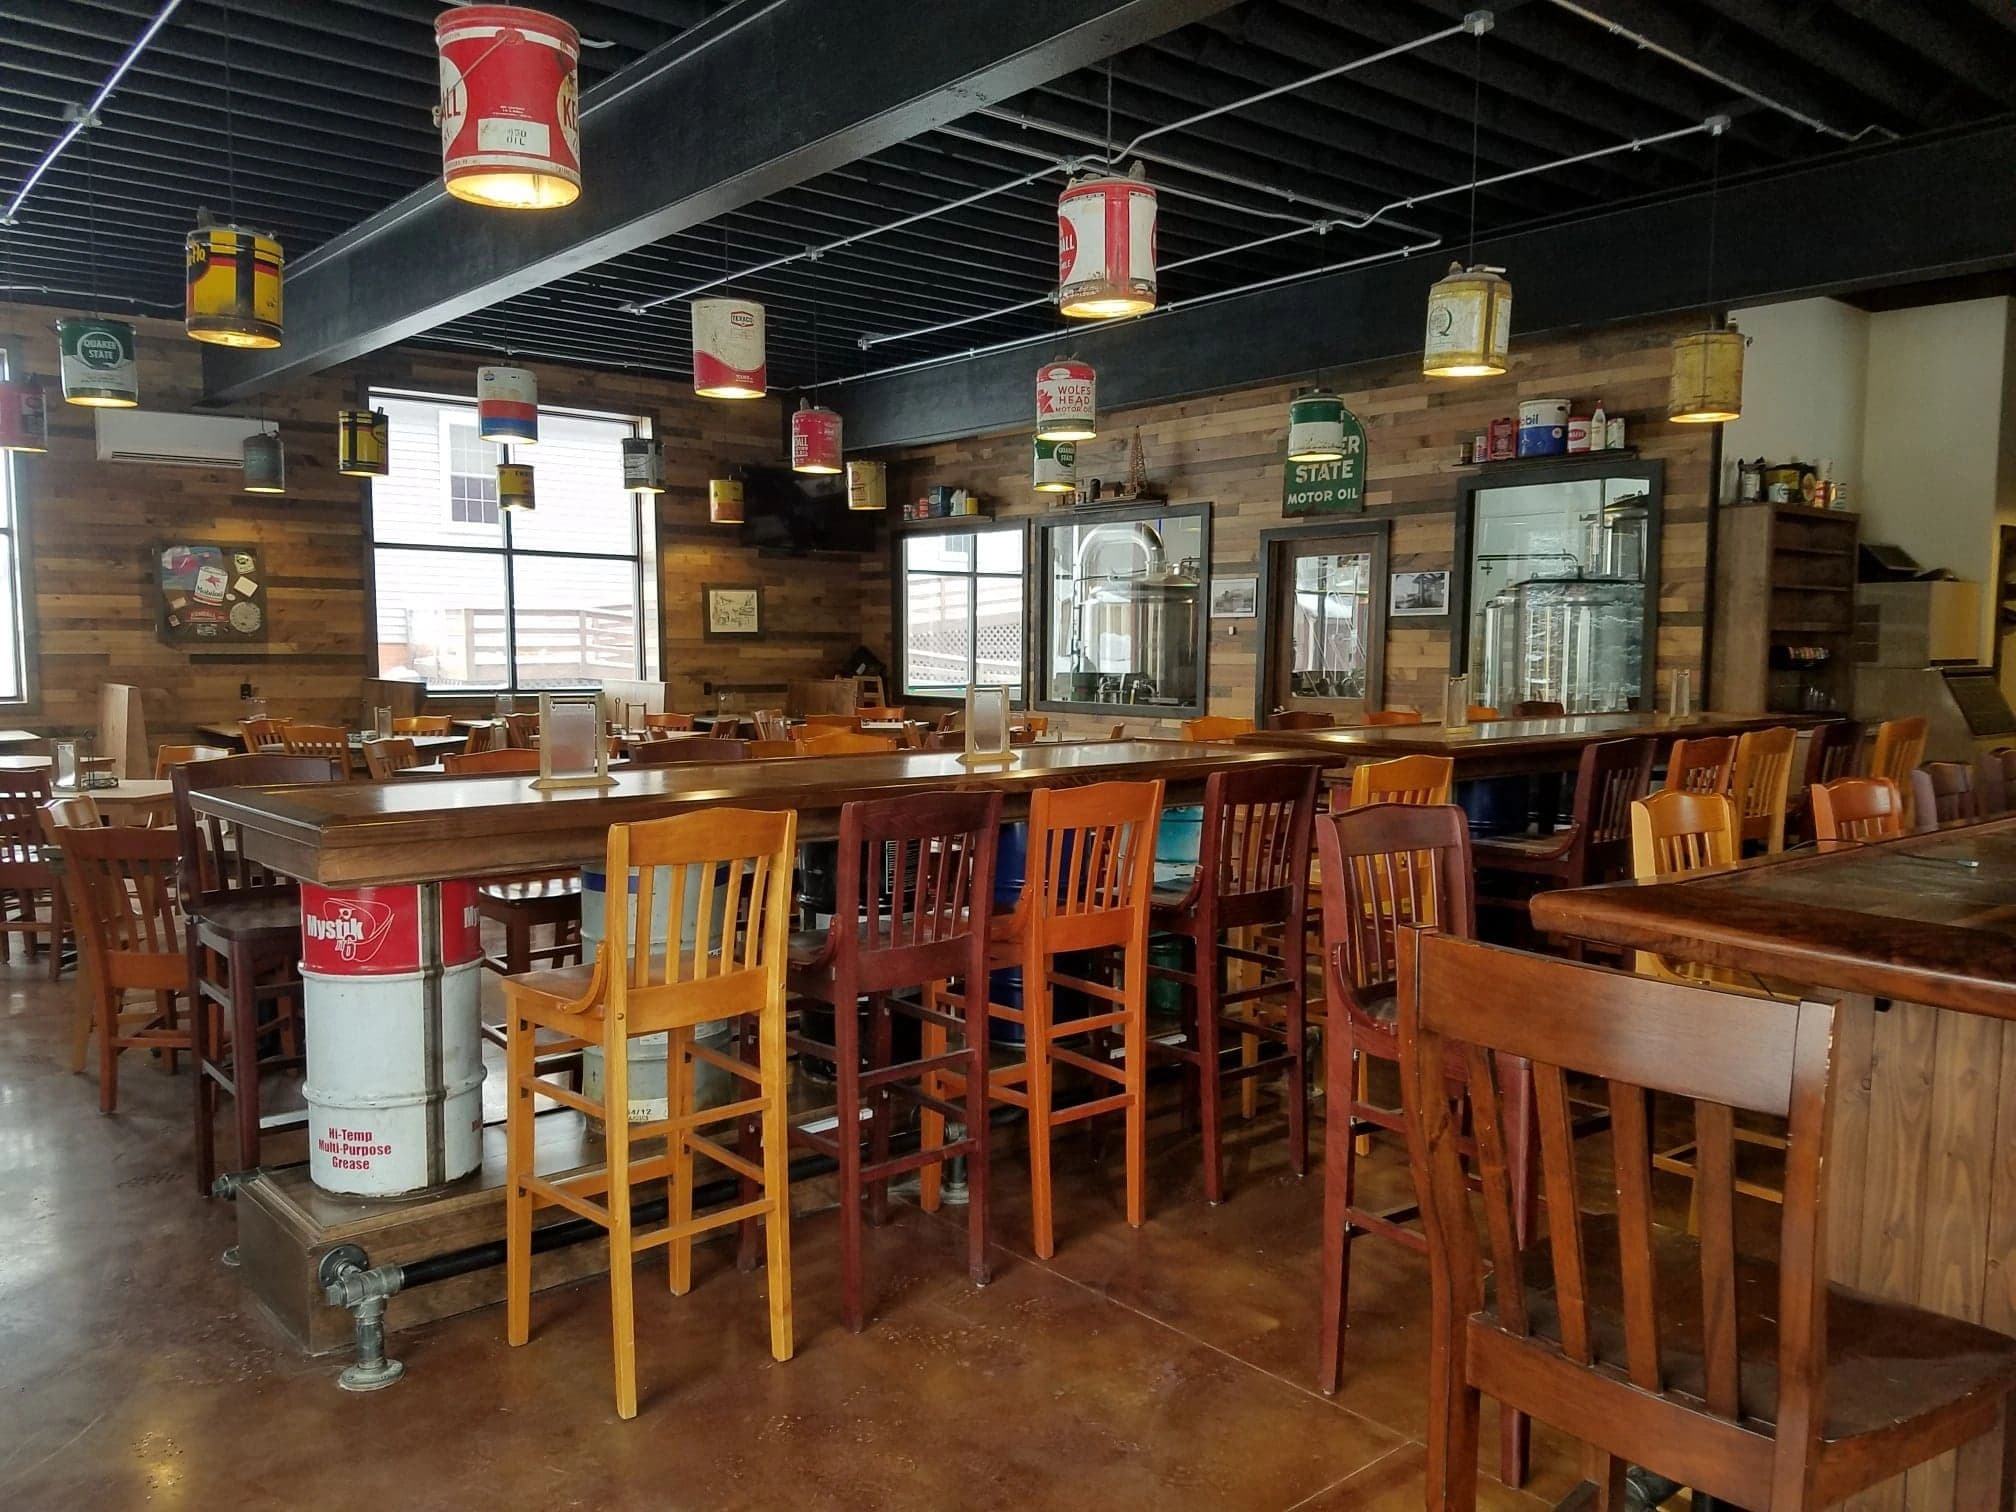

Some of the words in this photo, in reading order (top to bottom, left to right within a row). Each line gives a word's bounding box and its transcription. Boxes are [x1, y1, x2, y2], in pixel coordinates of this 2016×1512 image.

[84, 339, 117, 350] QUAKER
[88, 349, 114, 360] STATE
[1059, 396, 1090, 409] HEAD
[1296, 459, 1354, 484] STATE
[1288, 490, 1333, 505] MOTOR
[1337, 487, 1359, 500] OIL
[306, 911, 365, 941] Mystik
[328, 1127, 373, 1143] Hi-Temp
[318, 1139, 392, 1157] Multi-Purpose
[332, 1156, 370, 1170] Grease
